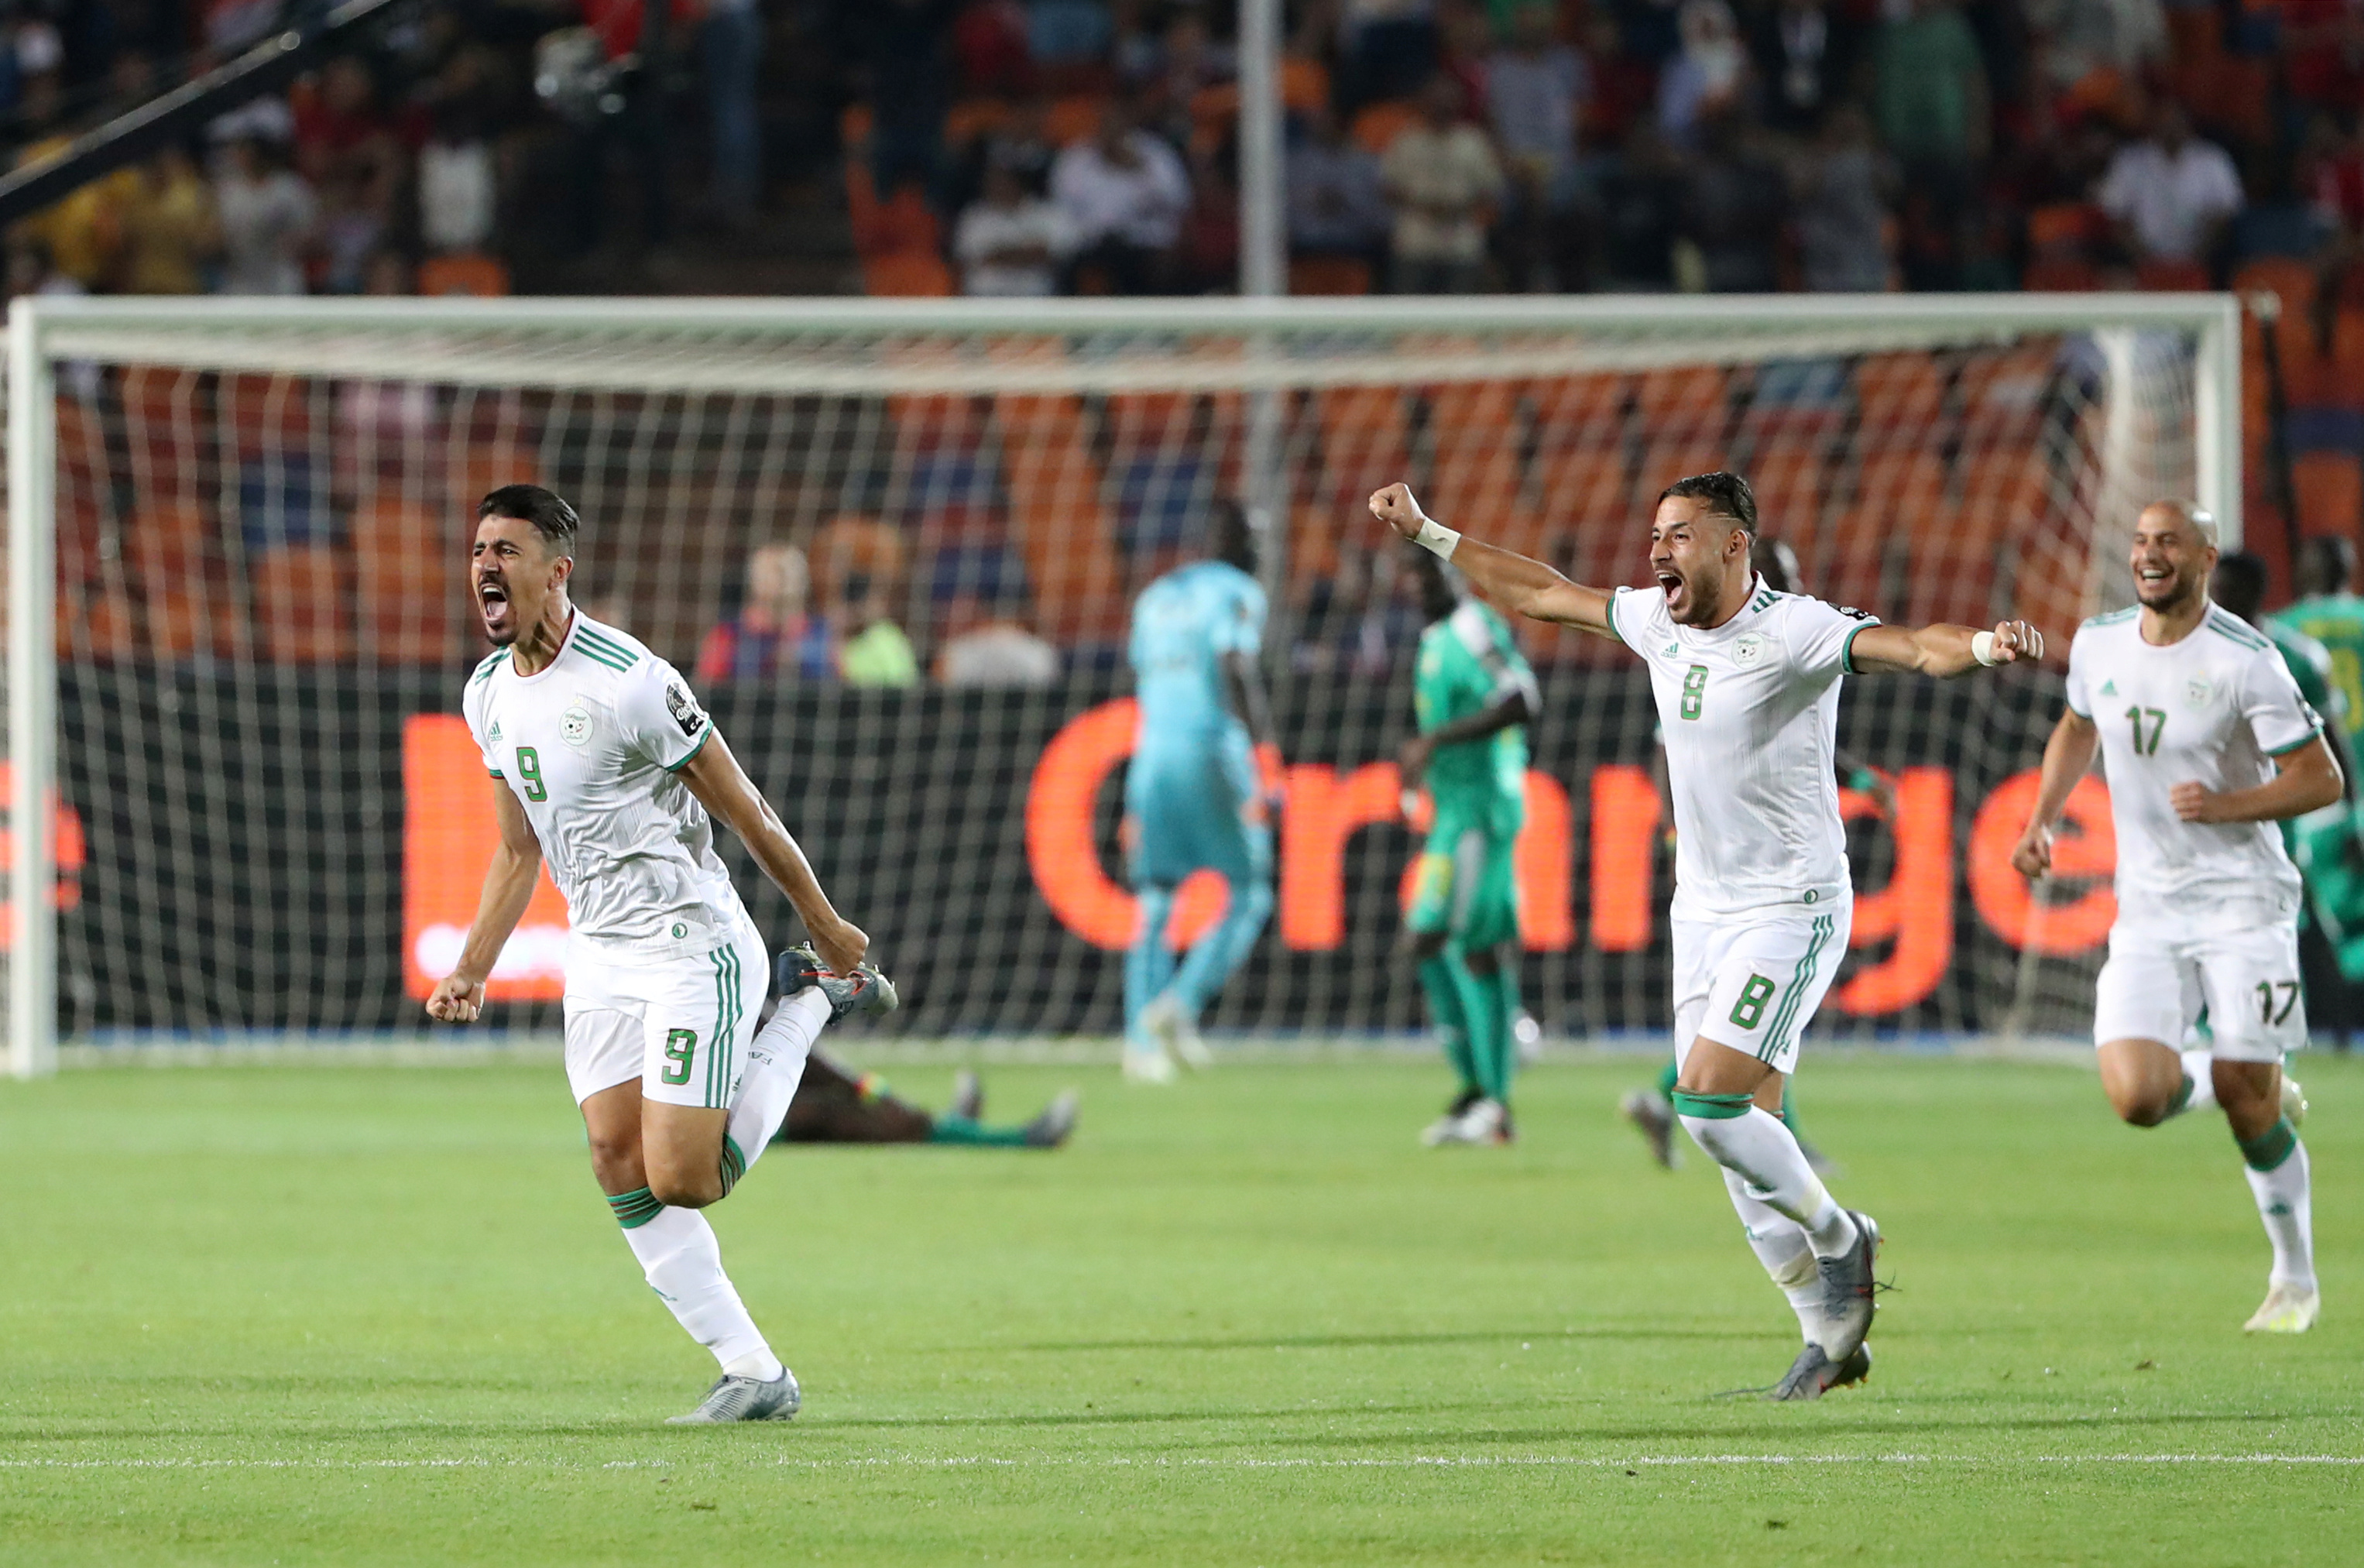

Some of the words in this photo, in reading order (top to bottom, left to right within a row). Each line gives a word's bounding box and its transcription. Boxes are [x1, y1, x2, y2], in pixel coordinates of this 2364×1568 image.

[1680, 664, 1709, 720] 8
[2126, 705, 2167, 756] 17
[516, 746, 547, 802] 9
[1729, 973, 1776, 1030] 8
[2256, 980, 2298, 1026] 17
[661, 1028, 698, 1085] 9
[747, 1051, 773, 1065] FA
